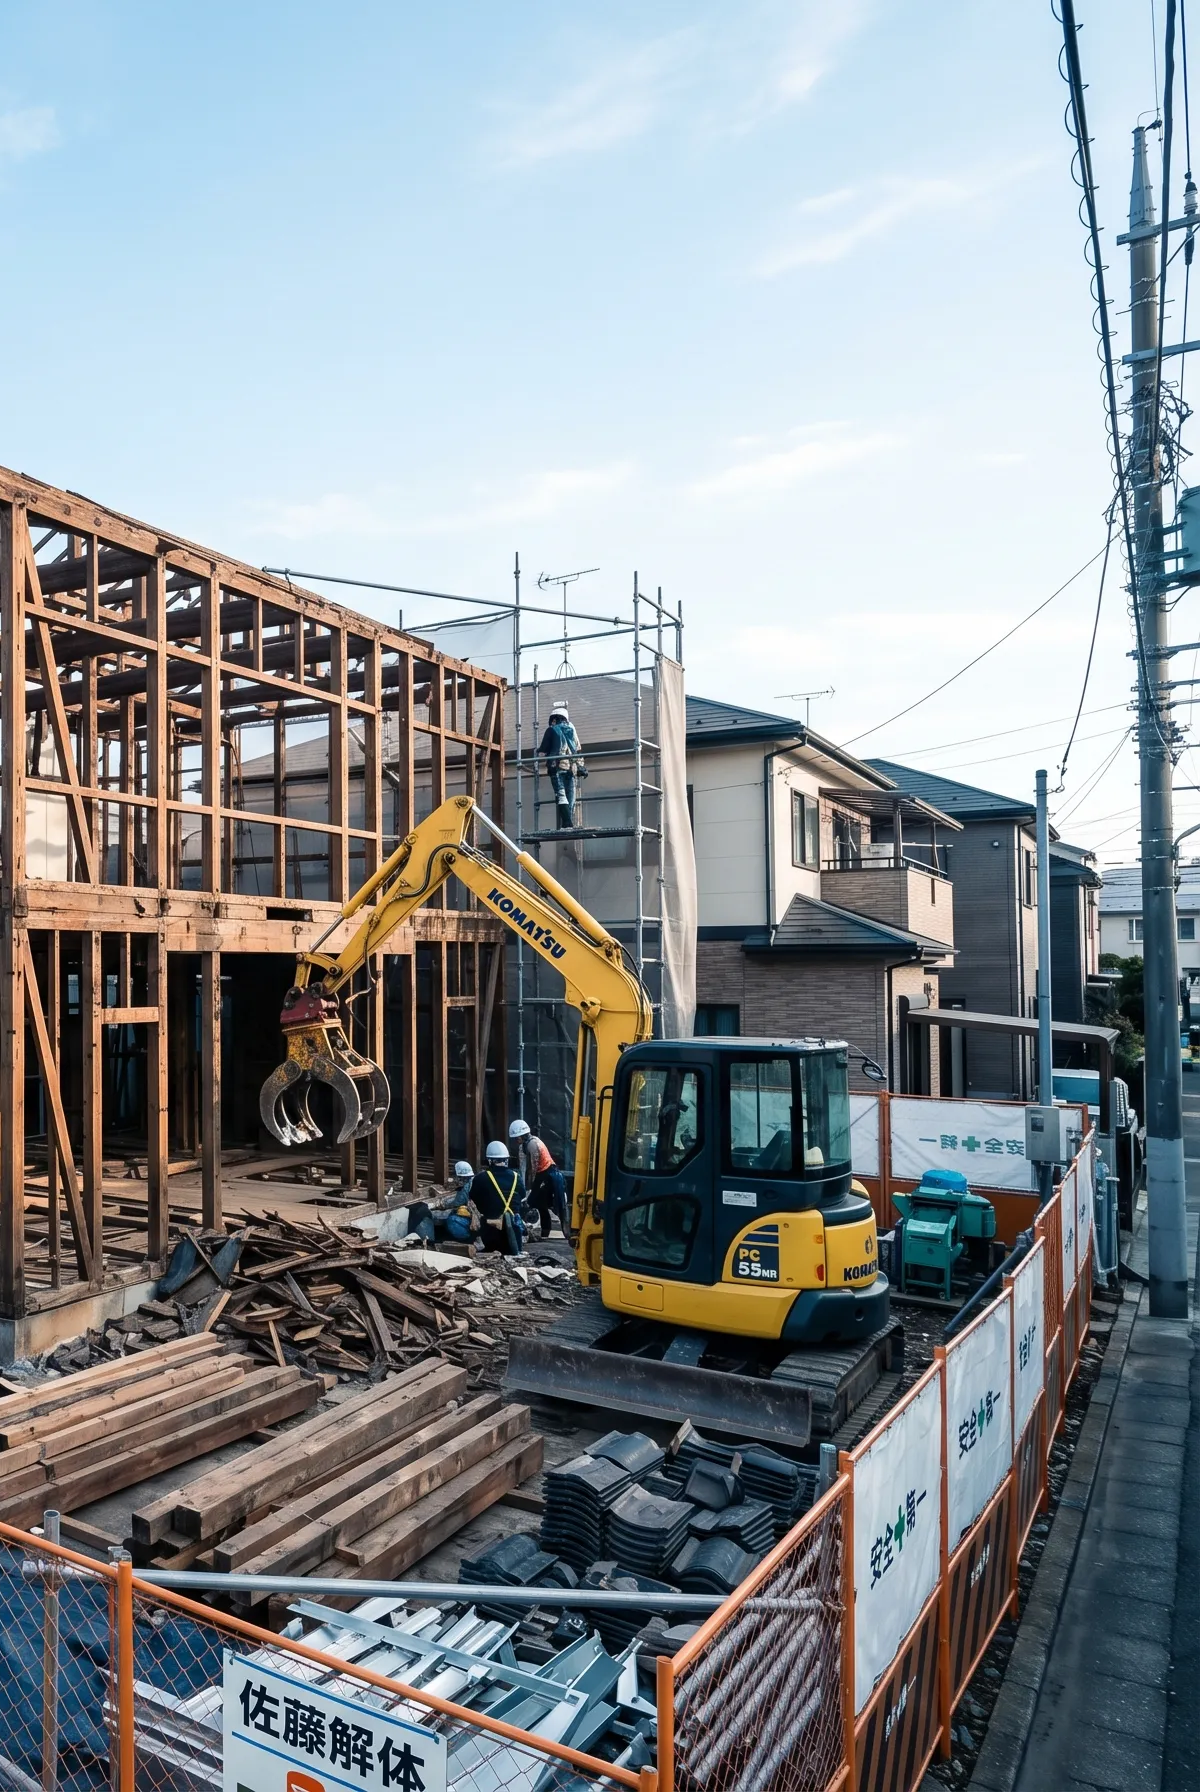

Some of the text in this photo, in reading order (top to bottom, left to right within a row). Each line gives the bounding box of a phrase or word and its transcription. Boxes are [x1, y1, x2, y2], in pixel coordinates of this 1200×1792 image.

[487, 888, 567, 959] KOMATSU
[738, 1261, 778, 1279] 55MR
[739, 1248, 760, 1262] PC
[239, 1678, 427, 1792] 佐藤解体
